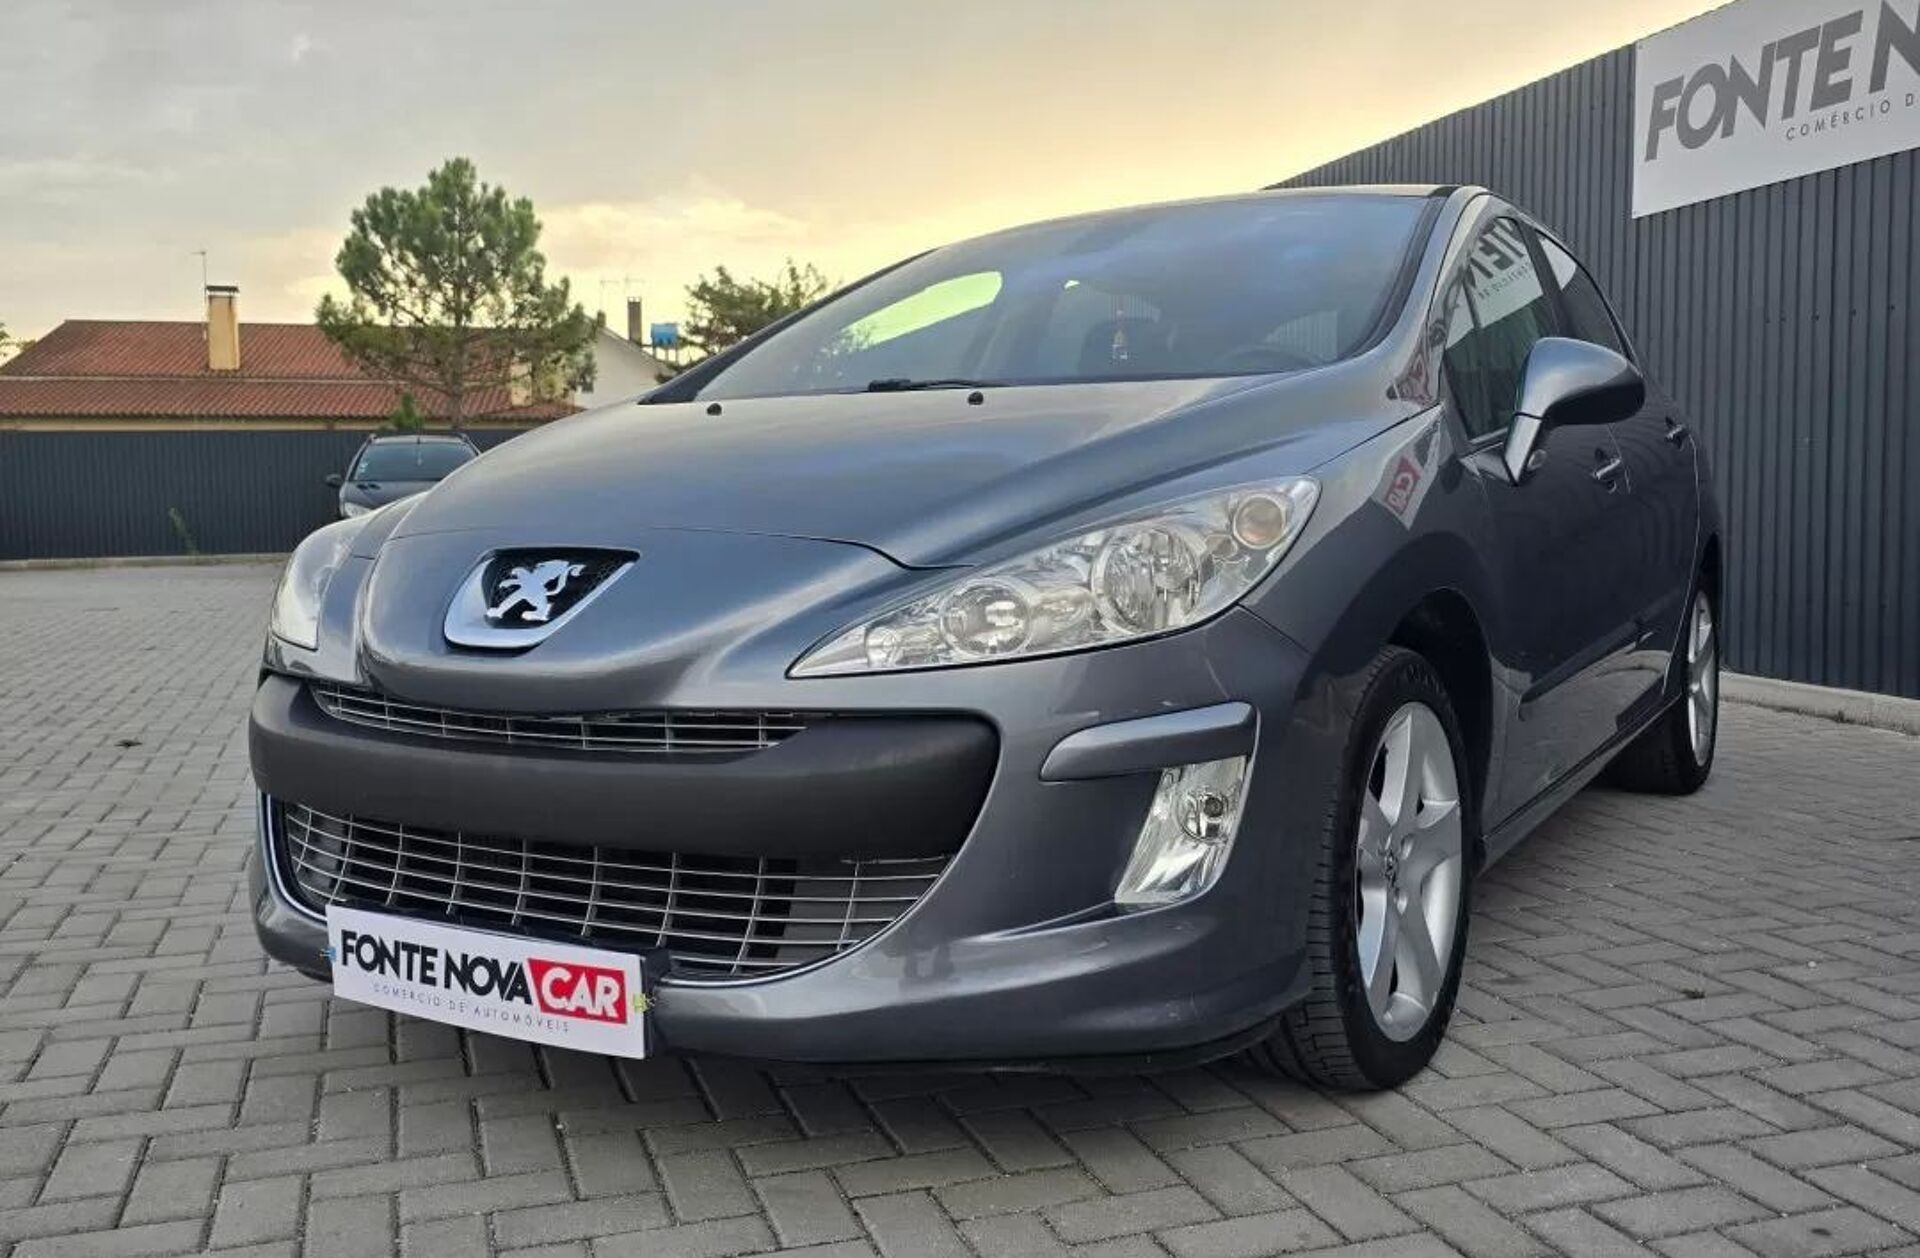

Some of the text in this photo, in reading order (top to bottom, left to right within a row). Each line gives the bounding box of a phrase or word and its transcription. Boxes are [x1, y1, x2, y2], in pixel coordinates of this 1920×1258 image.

[1644, 9, 1864, 163] FONTE
[1785, 99, 1891, 141] COMÉRCIO
[341, 929, 620, 1020] FONTE NOVA CAR
[449, 1000, 466, 1014] DE
[473, 1006, 570, 1033] AUTOMÓVEIS
